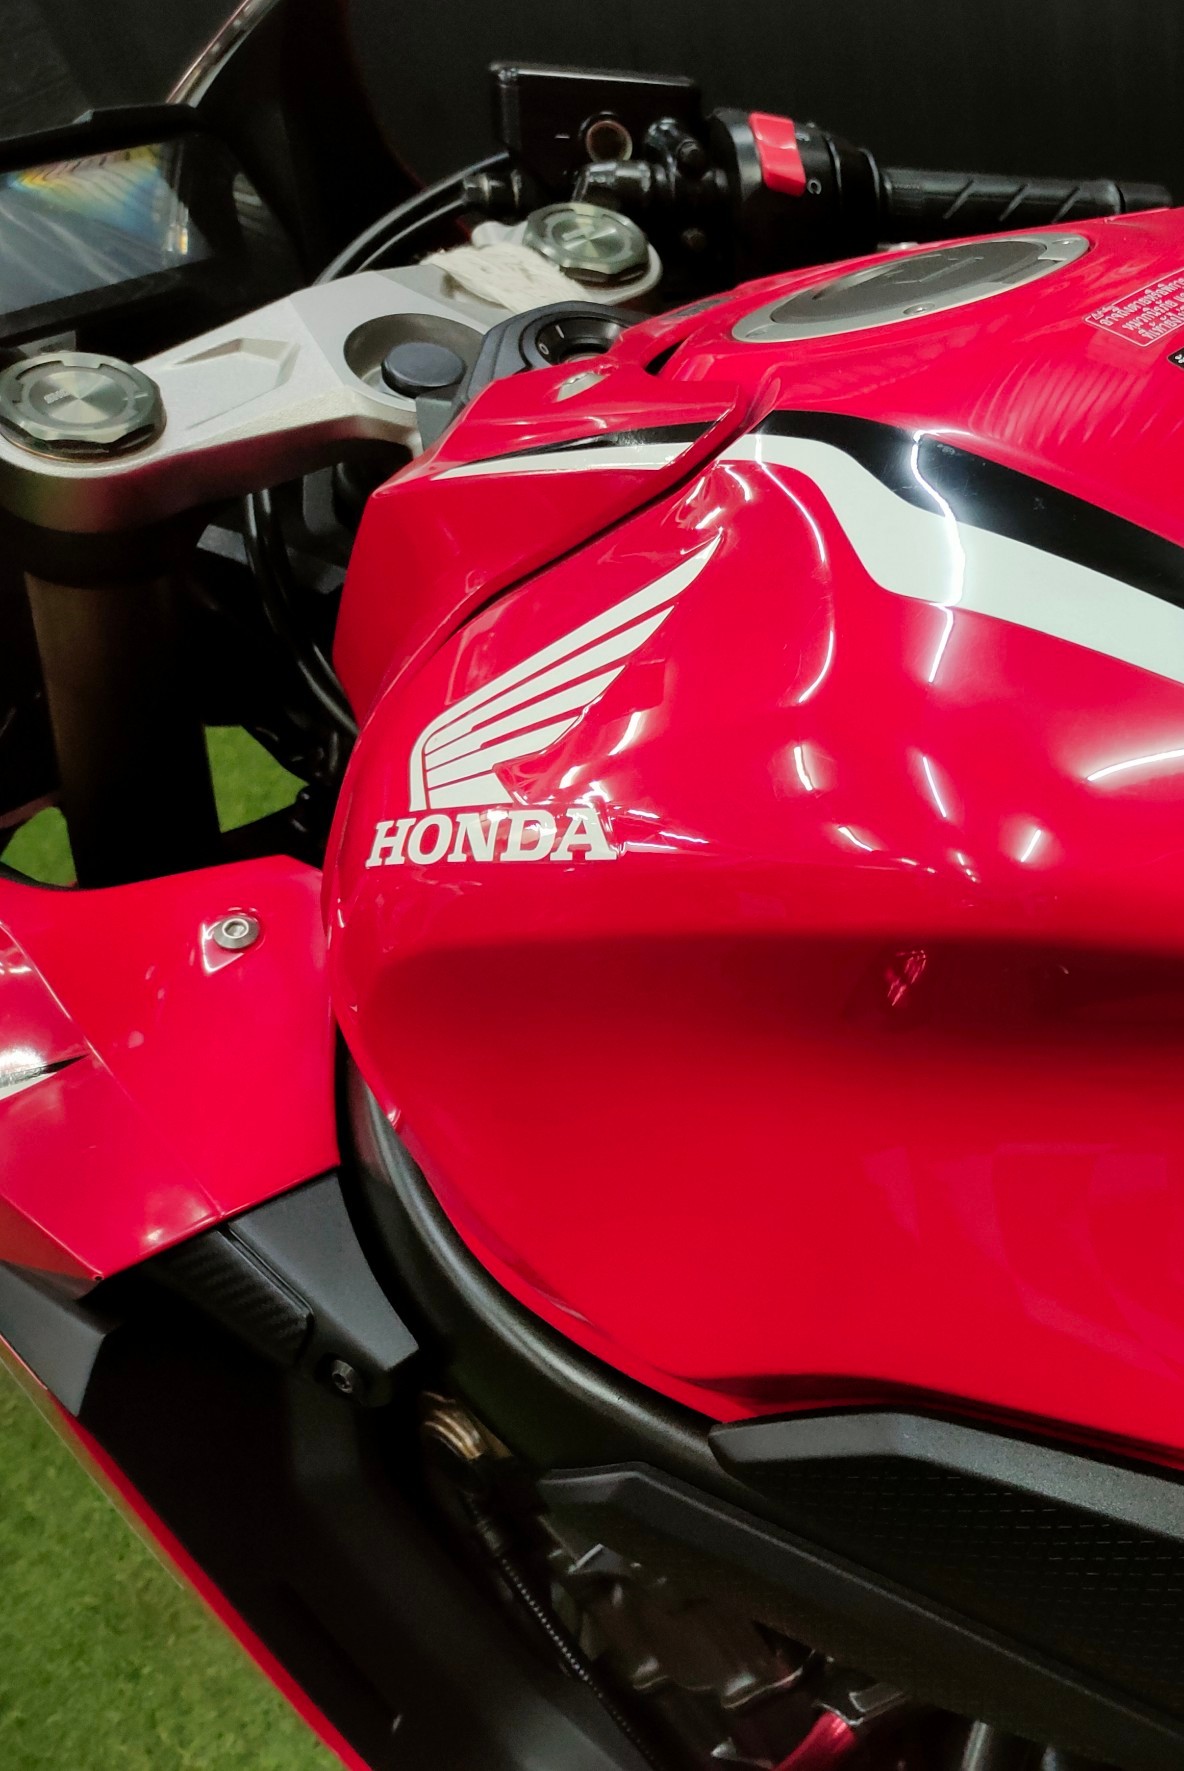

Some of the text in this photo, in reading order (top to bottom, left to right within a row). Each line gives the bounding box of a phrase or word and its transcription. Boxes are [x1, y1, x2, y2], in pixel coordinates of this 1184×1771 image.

[1122, 299, 1178, 331] หมวกนิรภัย
[365, 807, 618, 867] HONDA
